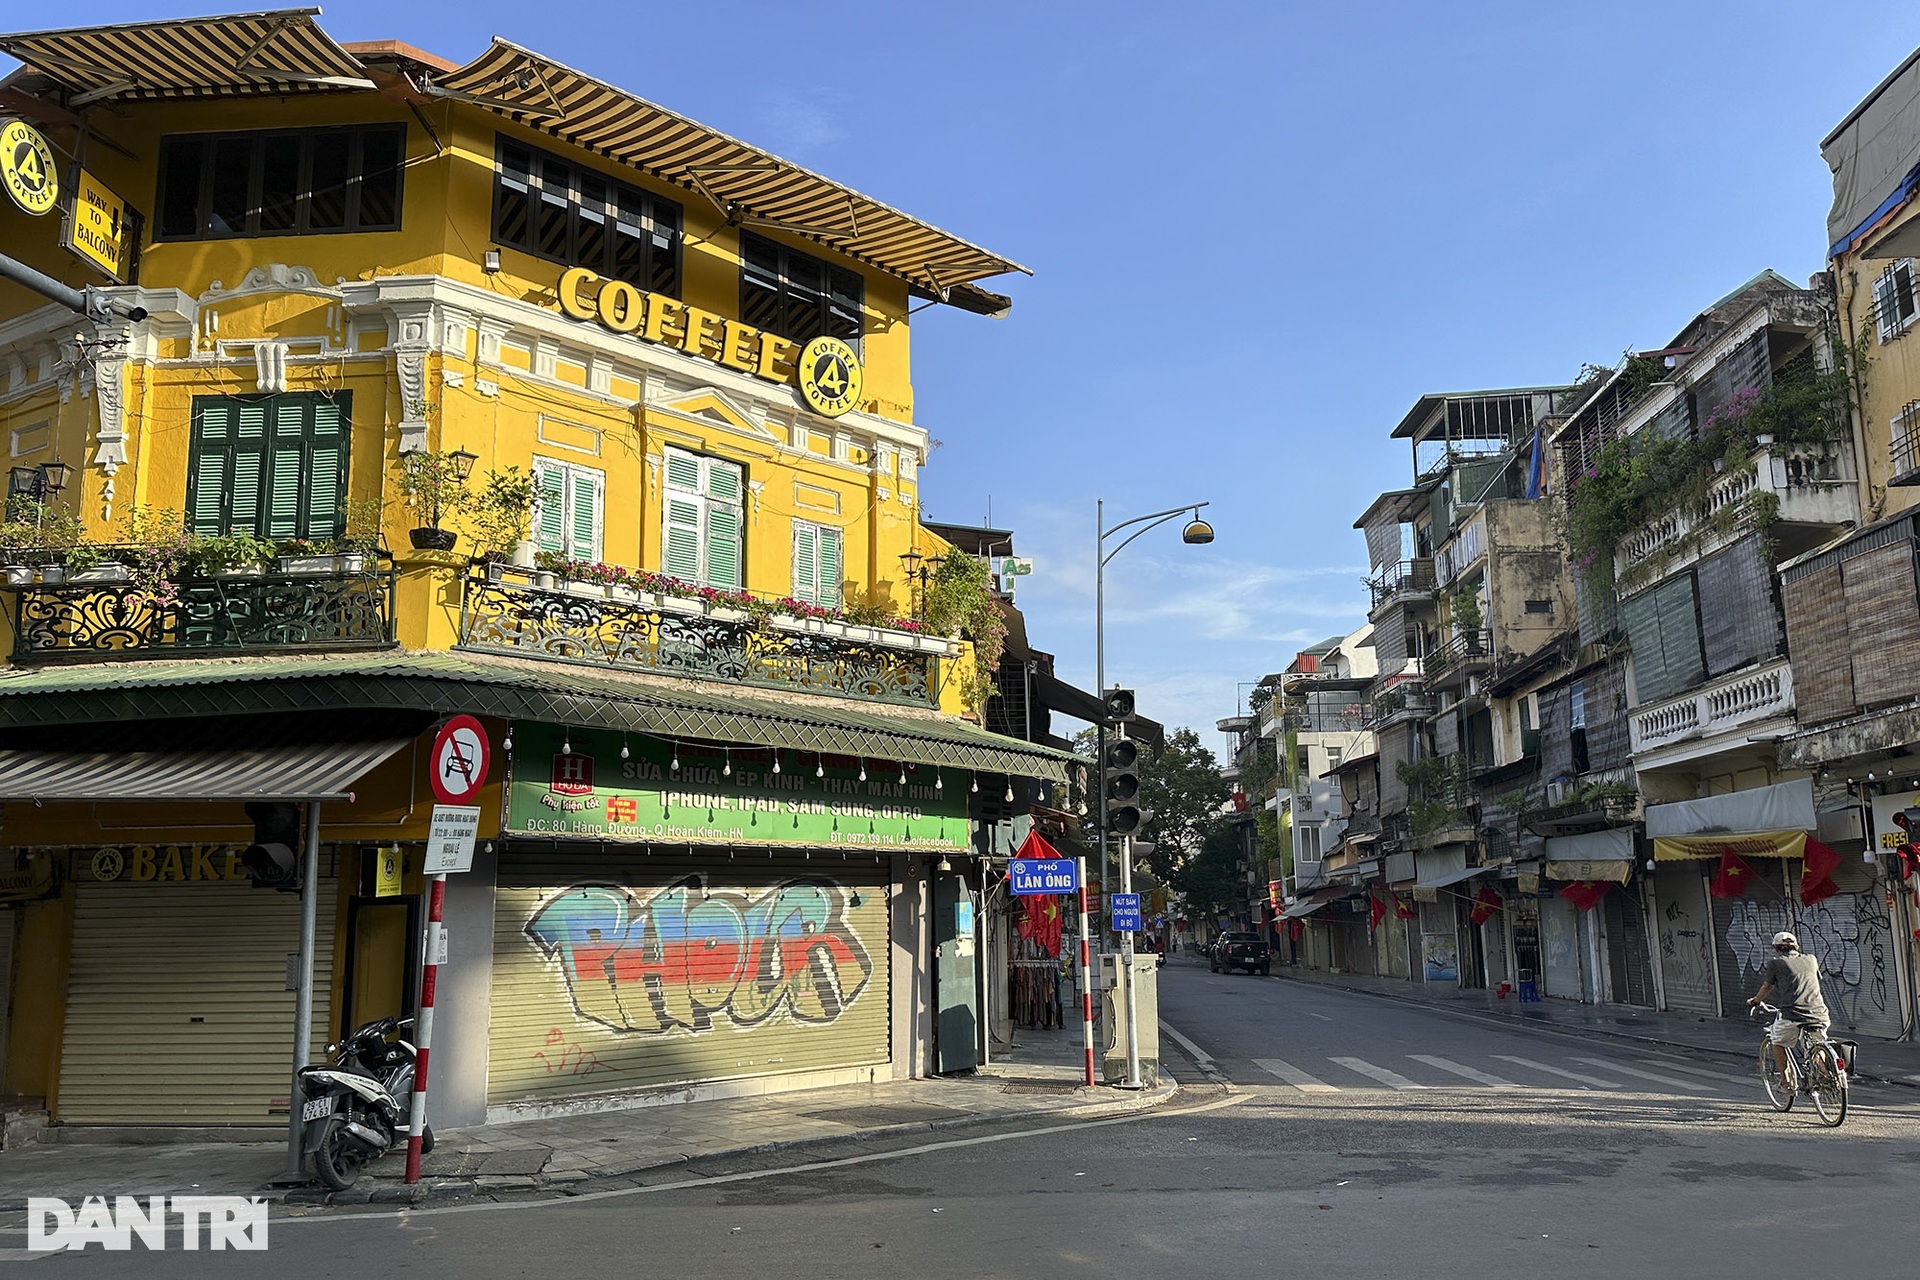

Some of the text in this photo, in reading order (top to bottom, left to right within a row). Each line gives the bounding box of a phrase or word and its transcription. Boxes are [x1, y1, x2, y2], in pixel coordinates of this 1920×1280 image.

[11, 128, 53, 170] COFFEE
[8, 168, 49, 205] COFFEE
[86, 188, 108, 212] WAY
[89, 208, 102, 226] TO
[77, 222, 118, 263] BALCONY
[557, 266, 793, 384] COFFEE
[812, 342, 857, 373] COFFEE
[805, 381, 852, 411] COFFEE
[622, 756, 663, 781] SỬA
[668, 763, 720, 786] CHỮA
[735, 767, 758, 788] ÉP
[822, 778, 861, 795] THAY
[867, 781, 904, 799] MÀN
[908, 782, 944, 802] HÌNH
[563, 800, 583, 813] kiện
[585, 797, 600, 810] tốt
[739, 795, 785, 815] IPAD,
[787, 798, 826, 816] SAM
[830, 802, 879, 819] SUNG,
[881, 806, 922, 820] OPPO
[527, 819, 550, 832] ĐC:
[553, 820, 567, 833] 80
[572, 820, 603, 836] Hàng
[608, 821, 647, 838] Đường
[667, 824, 694, 837] Hoàn
[729, 829, 743, 839] HN
[847, 832, 866, 844] 0972
[867, 833, 881, 845] 139
[882, 835, 894, 845] 114
[1037, 861, 1058, 871] PHỐ
[1017, 872, 1072, 889] LÃN ÔNG
[1113, 908, 1124, 916] CHO
